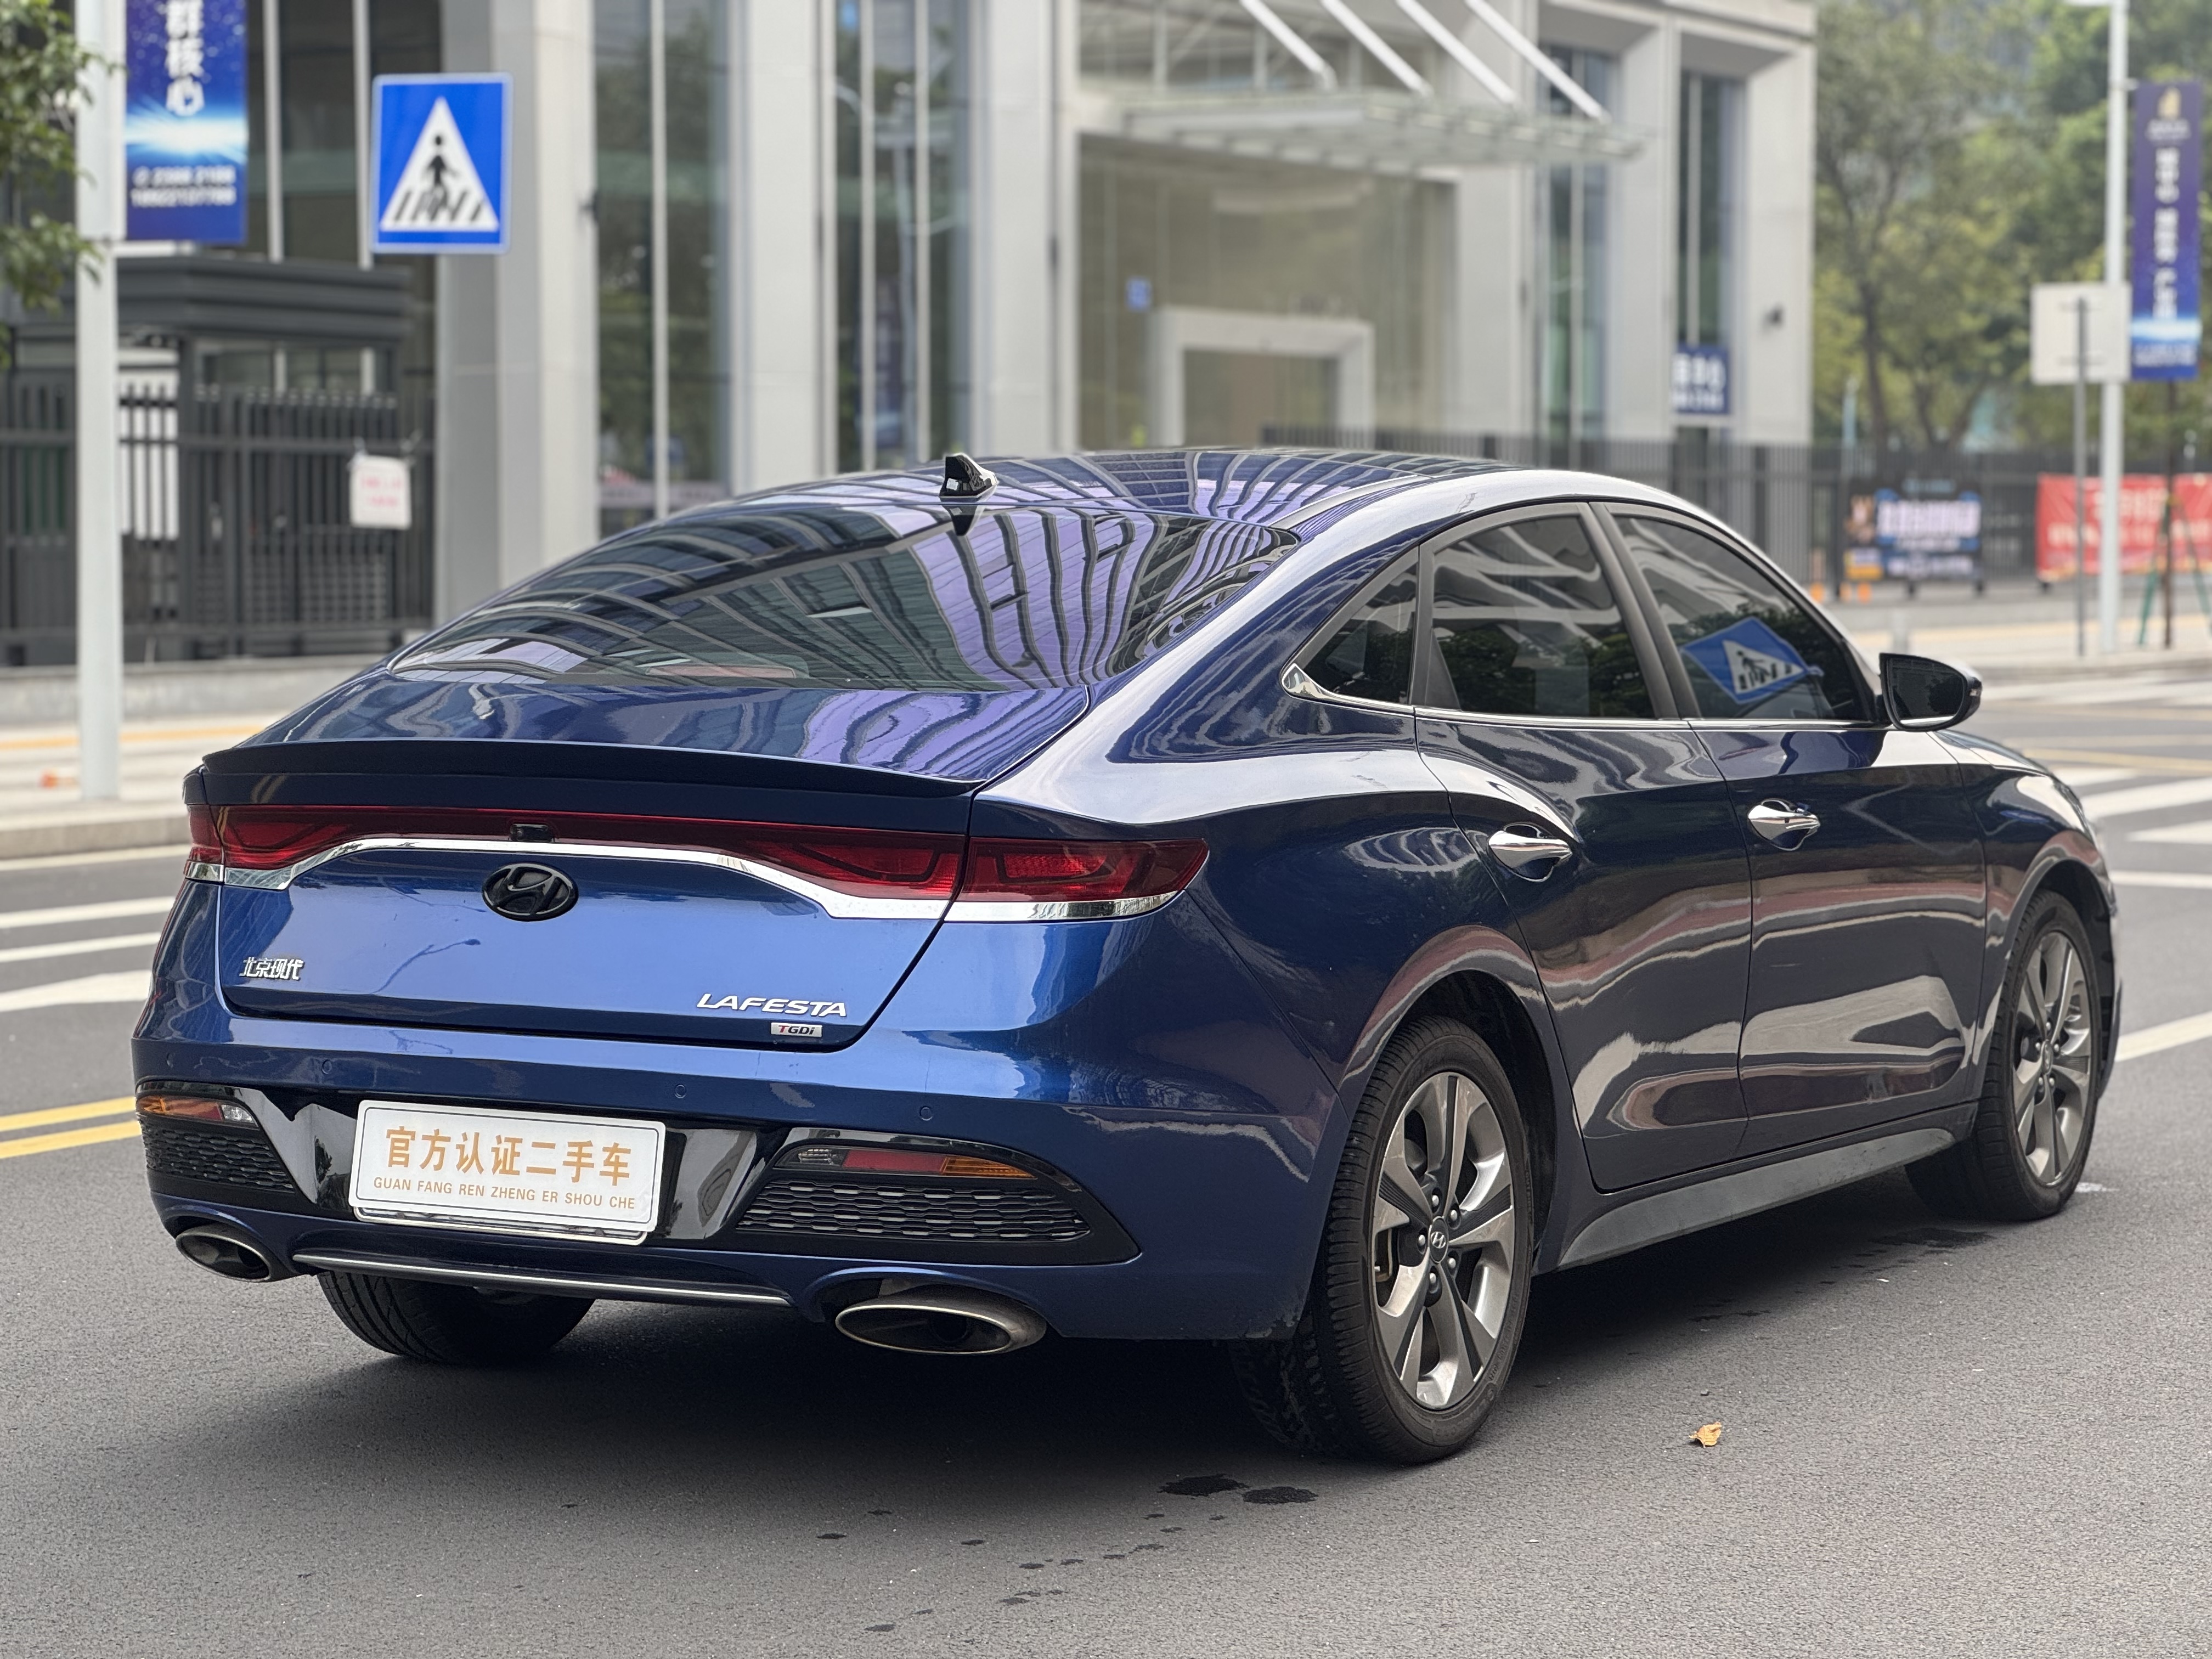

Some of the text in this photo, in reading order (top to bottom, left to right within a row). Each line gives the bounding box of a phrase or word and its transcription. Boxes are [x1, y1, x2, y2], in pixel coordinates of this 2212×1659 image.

[239, 957, 303, 980] 北京现代
[696, 994, 847, 1017] LAFESTA
[778, 1025, 815, 1035] TGDi
[386, 1126, 631, 1186] 官方认证二手车
[374, 1177, 635, 1209] GUAN FANG REN ZHENG ER SHOU CHE
